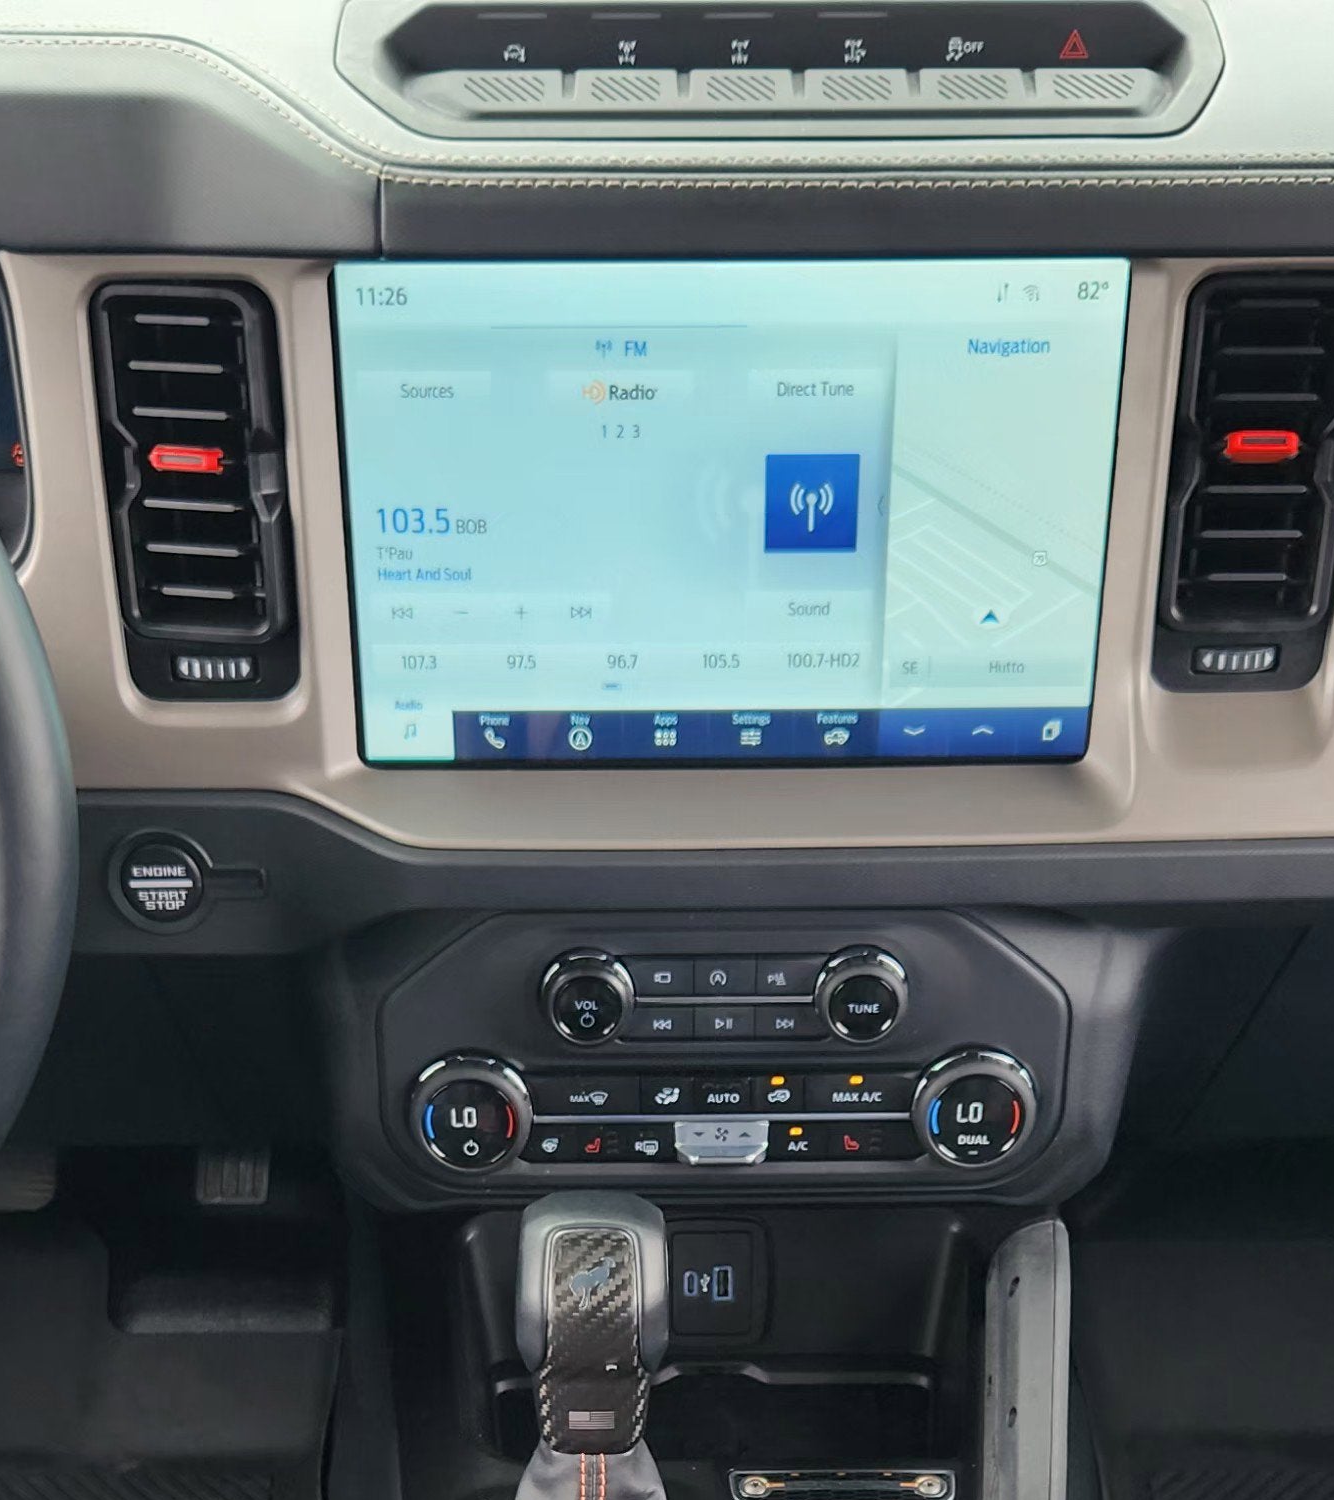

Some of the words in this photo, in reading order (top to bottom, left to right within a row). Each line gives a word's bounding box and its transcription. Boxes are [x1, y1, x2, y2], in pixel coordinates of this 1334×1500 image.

[964, 41, 984, 55] OFF
[356, 287, 407, 306] 11:26
[1077, 281, 1109, 300] 82°
[624, 341, 647, 356] FM
[968, 338, 1050, 357] Navigation
[400, 384, 454, 399] Sources
[609, 385, 655, 401] Radio
[777, 382, 816, 397] Direct
[821, 381, 854, 396] Tune
[602, 425, 607, 438] 1
[616, 425, 624, 438] 2
[632, 425, 640, 438] 3
[377, 508, 450, 534] 103.5
[456, 519, 487, 534] BOB
[378, 567, 411, 581] Heart
[416, 567, 441, 581] And
[443, 567, 471, 581] Soul
[788, 601, 830, 616] Sound
[401, 655, 437, 670] 107.3
[507, 655, 536, 670] 97.5
[607, 655, 638, 669] 96.7
[703, 654, 740, 669] 105.5
[787, 653, 860, 668] 100.7-HD2
[902, 661, 918, 675] SE
[394, 700, 423, 711] Audio
[479, 714, 510, 726] Phone
[571, 713, 589, 725] Nav
[654, 714, 678, 726] Apps
[732, 713, 771, 726] Settings
[817, 713, 858, 725] Features
[132, 865, 187, 877] ENGINE
[138, 890, 188, 901] START
[145, 900, 185, 911] STOP
[575, 1000, 598, 1011] VOL
[848, 1003, 880, 1014] TUNE
[570, 1094, 590, 1103] MAX
[707, 1092, 740, 1104] AUTO
[832, 1091, 859, 1102] MAX
[861, 1091, 882, 1103] A/C
[450, 1106, 477, 1128] LO
[956, 1101, 983, 1124] LO
[788, 1140, 808, 1151] A/C
[957, 1134, 990, 1145] DUAL
